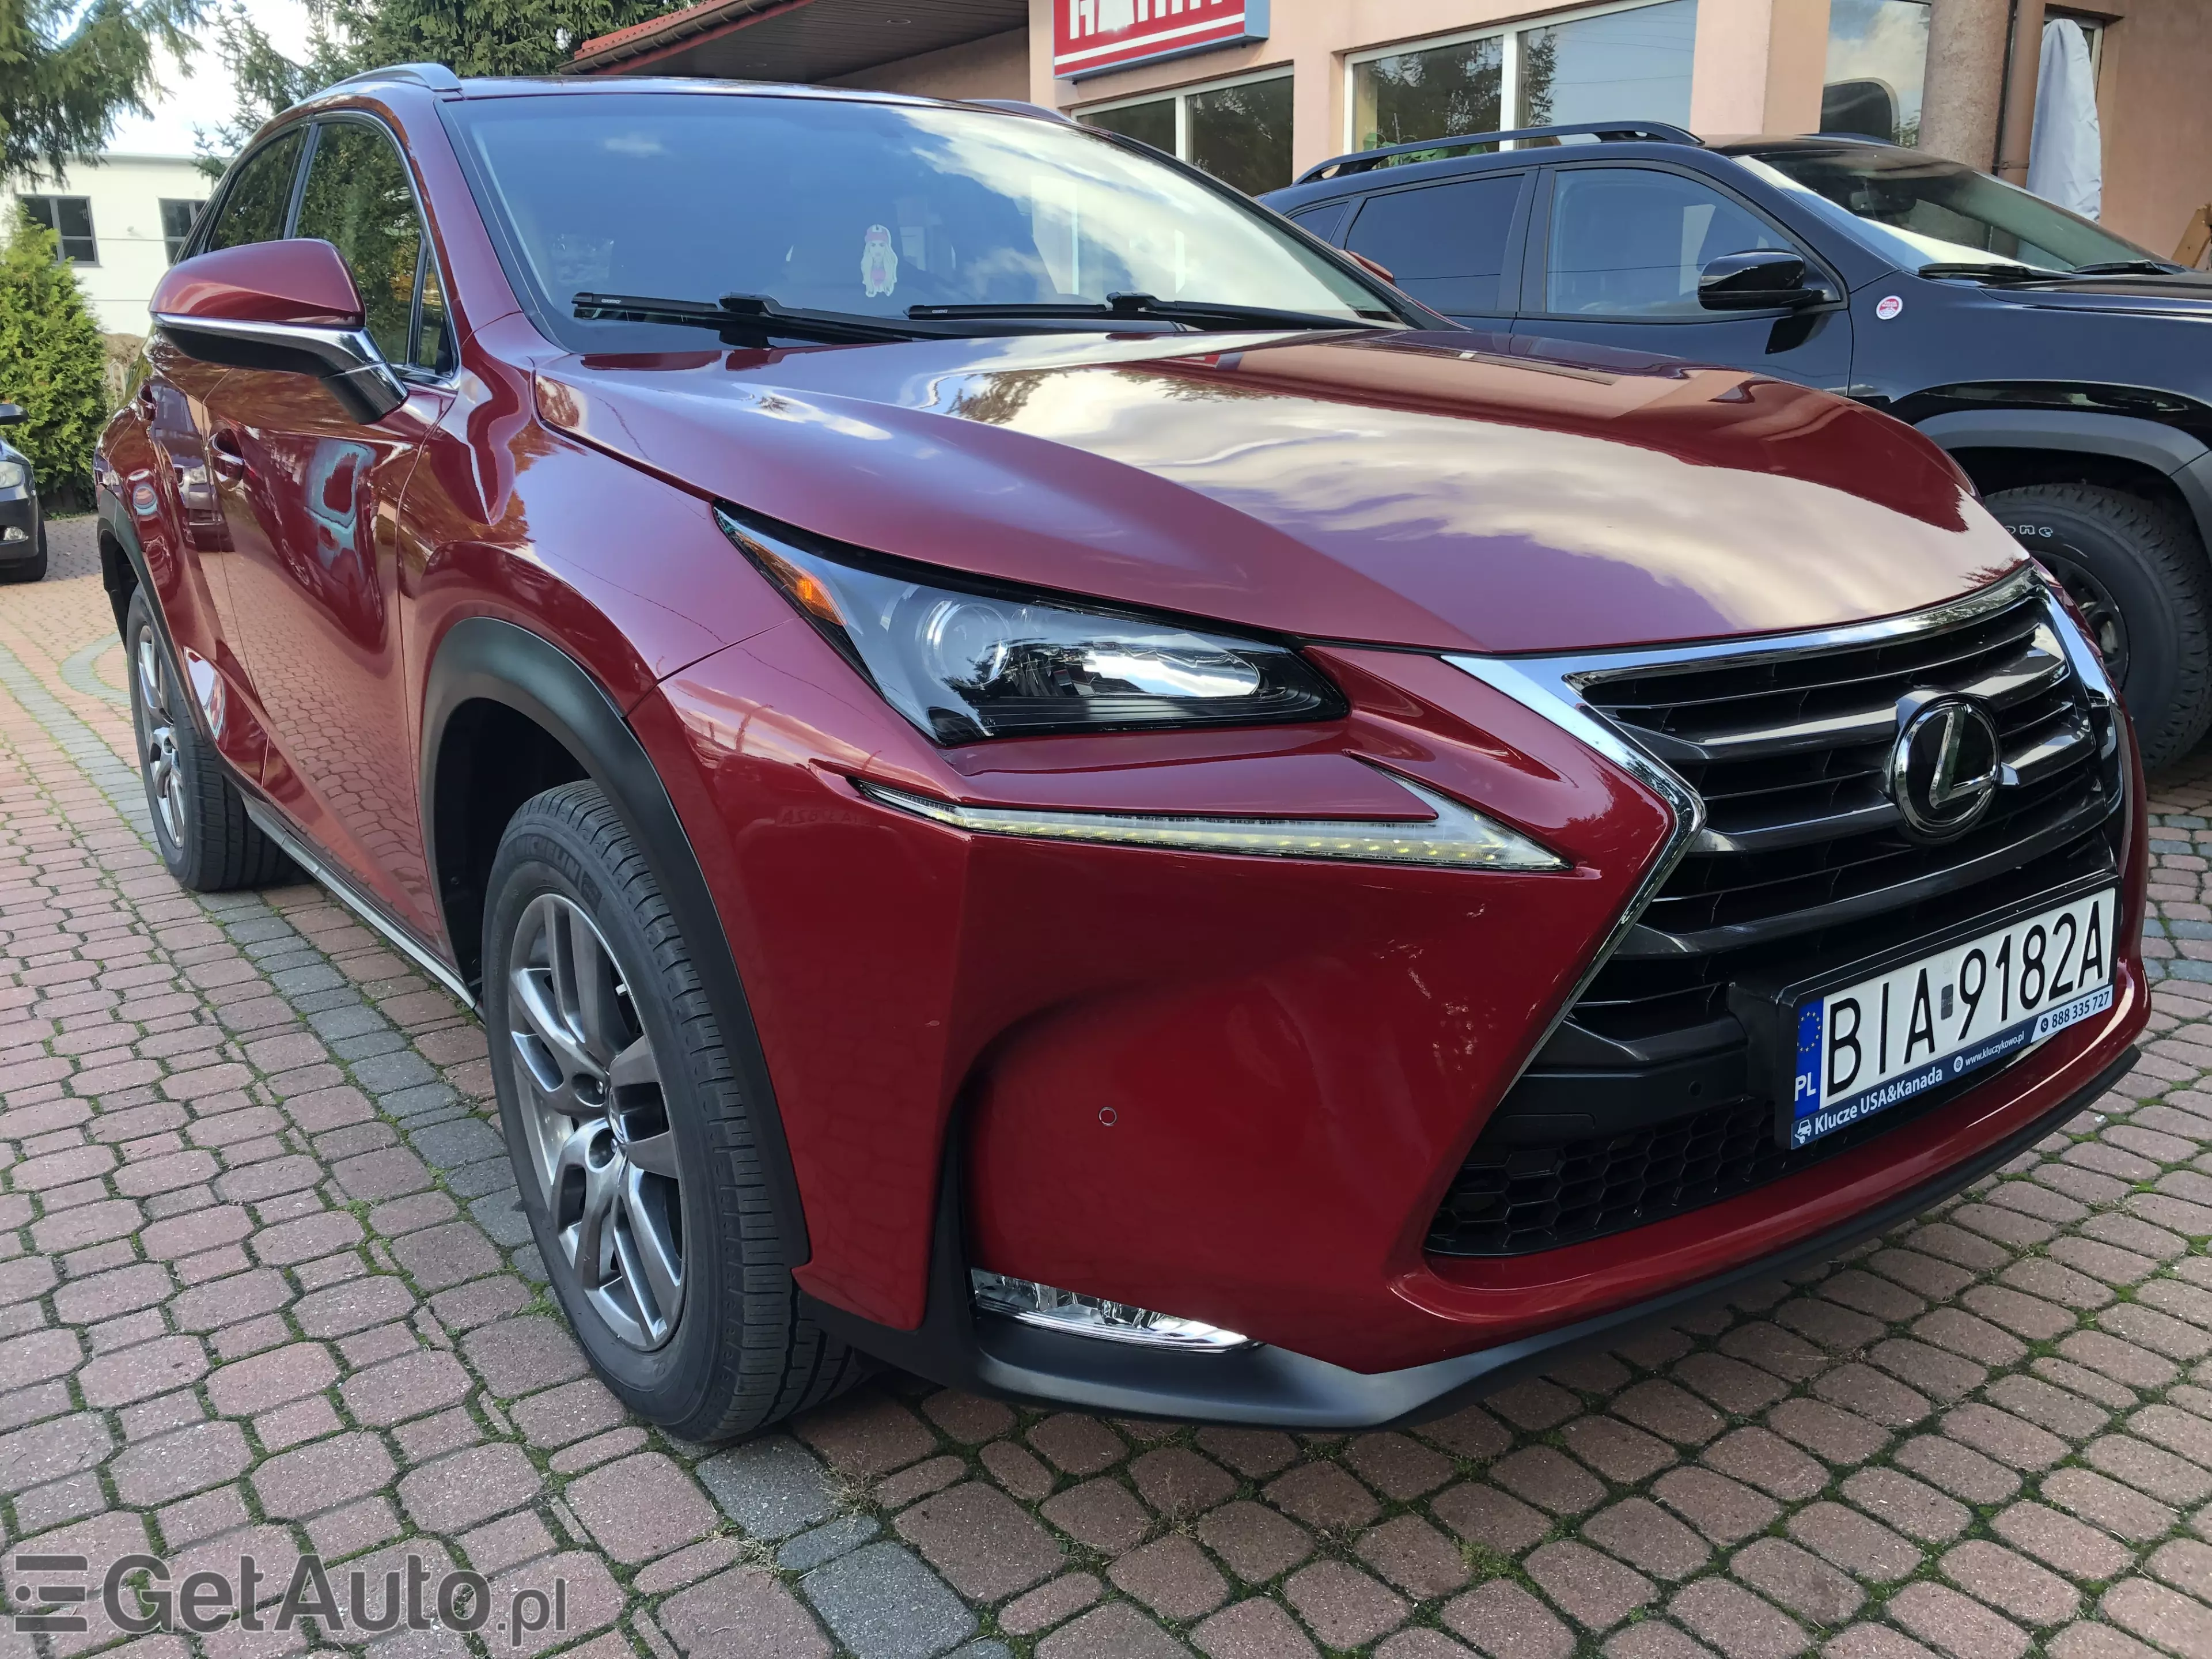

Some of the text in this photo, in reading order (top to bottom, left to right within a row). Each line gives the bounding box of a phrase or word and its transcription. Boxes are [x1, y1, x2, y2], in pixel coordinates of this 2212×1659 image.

[1826, 900, 2104, 1099] BIA 9182A
[2051, 990, 2111, 1028] 888 335 727
[1965, 1031, 2025, 1067] www.kluczykowo.pl
[1794, 1071, 1816, 1101] PL
[1814, 1066, 1943, 1135] Klucze USA&Kanada
